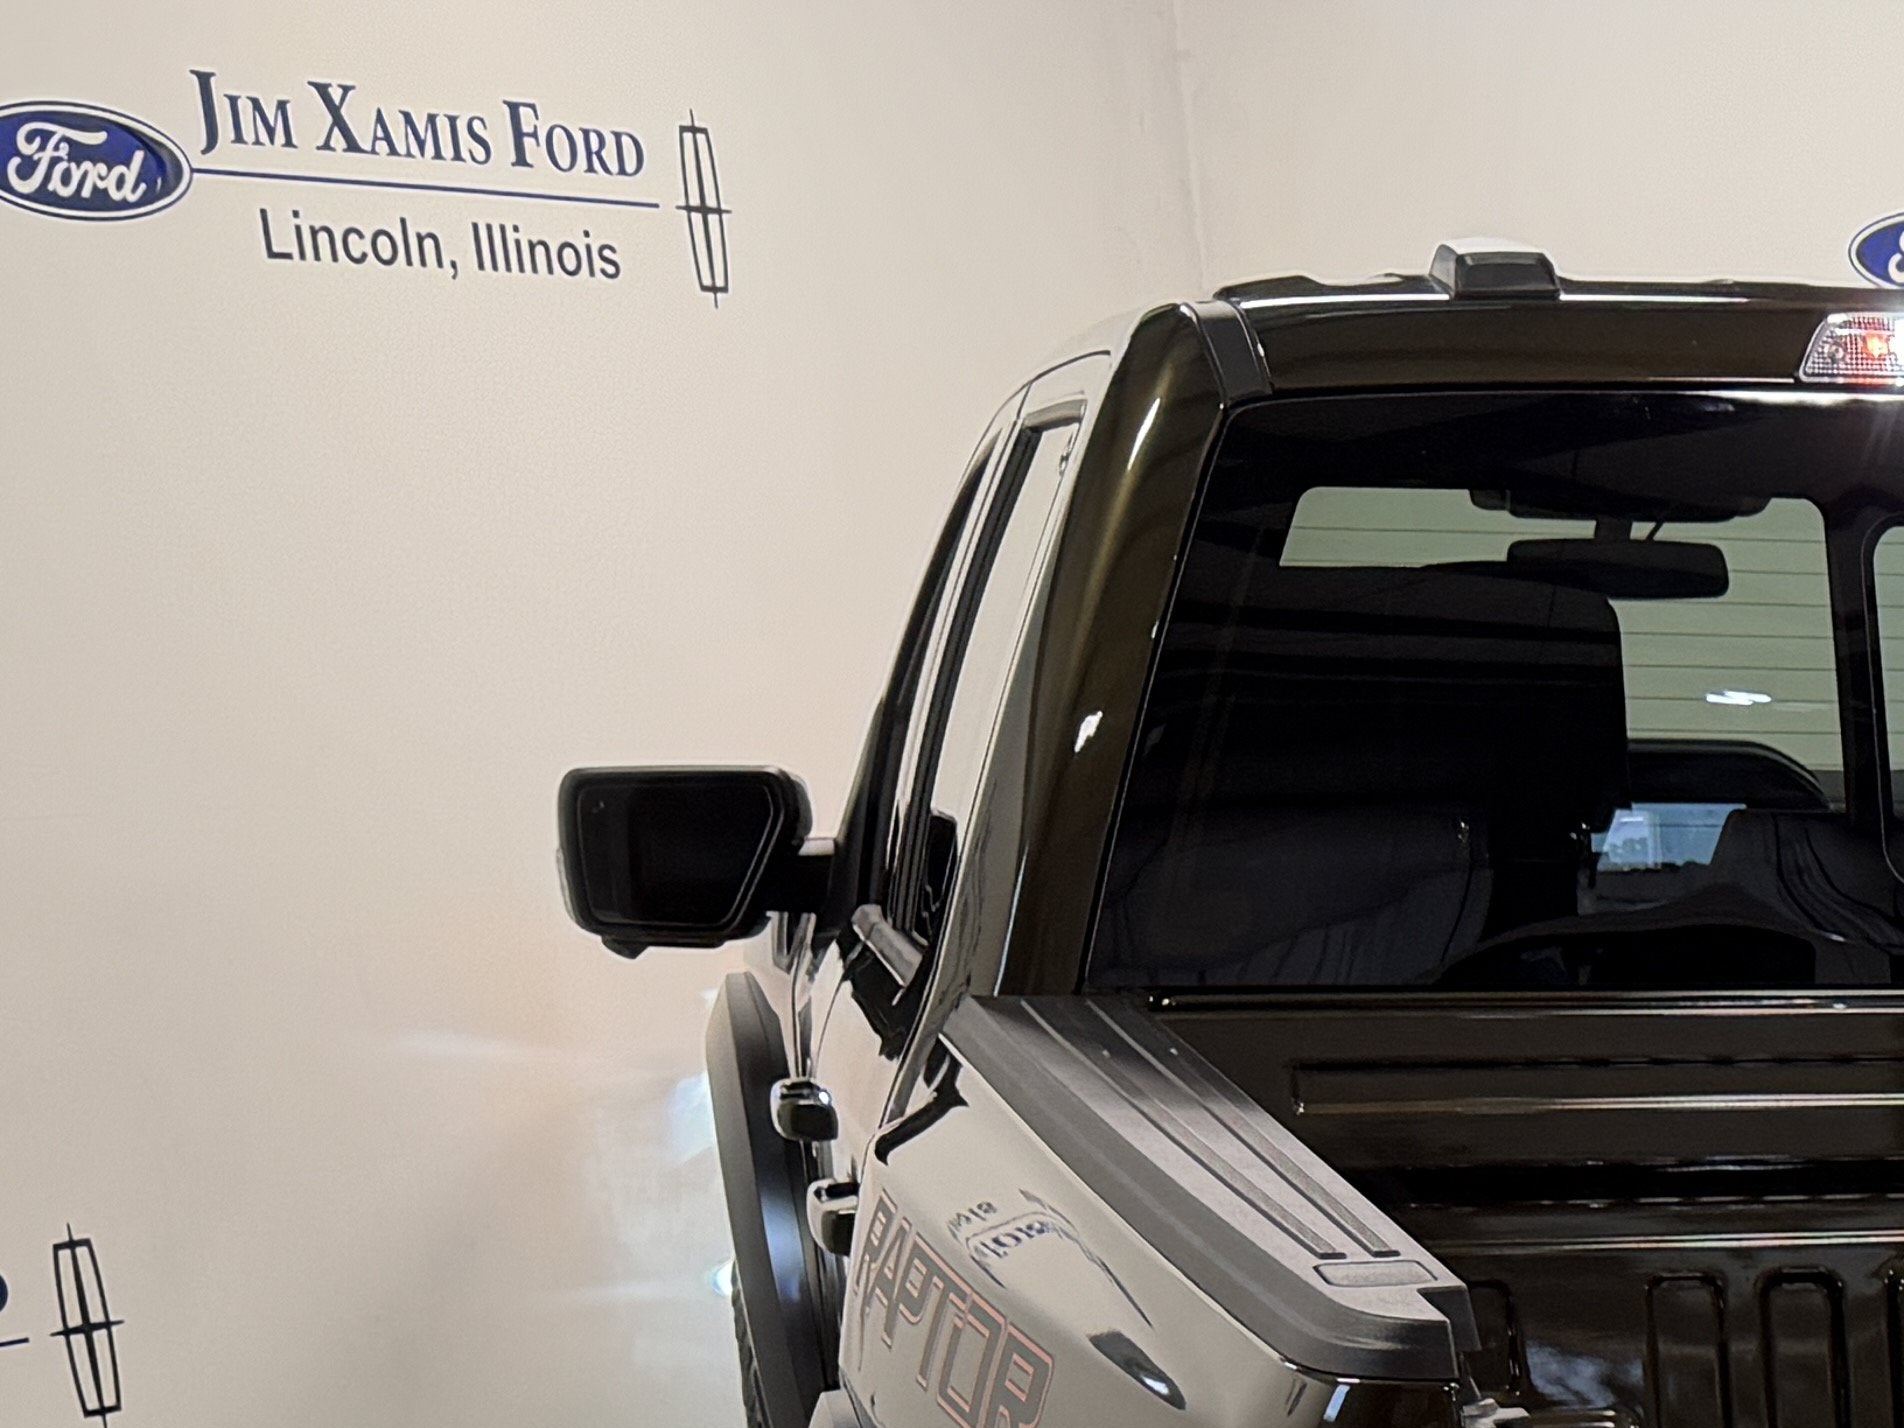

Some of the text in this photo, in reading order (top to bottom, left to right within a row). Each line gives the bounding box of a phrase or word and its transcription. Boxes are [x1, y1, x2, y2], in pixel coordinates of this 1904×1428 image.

[6, 121, 147, 203] Ford
[190, 69, 645, 178] JIM XAMIS FORD
[259, 207, 621, 281] Lincoln, Illinois
